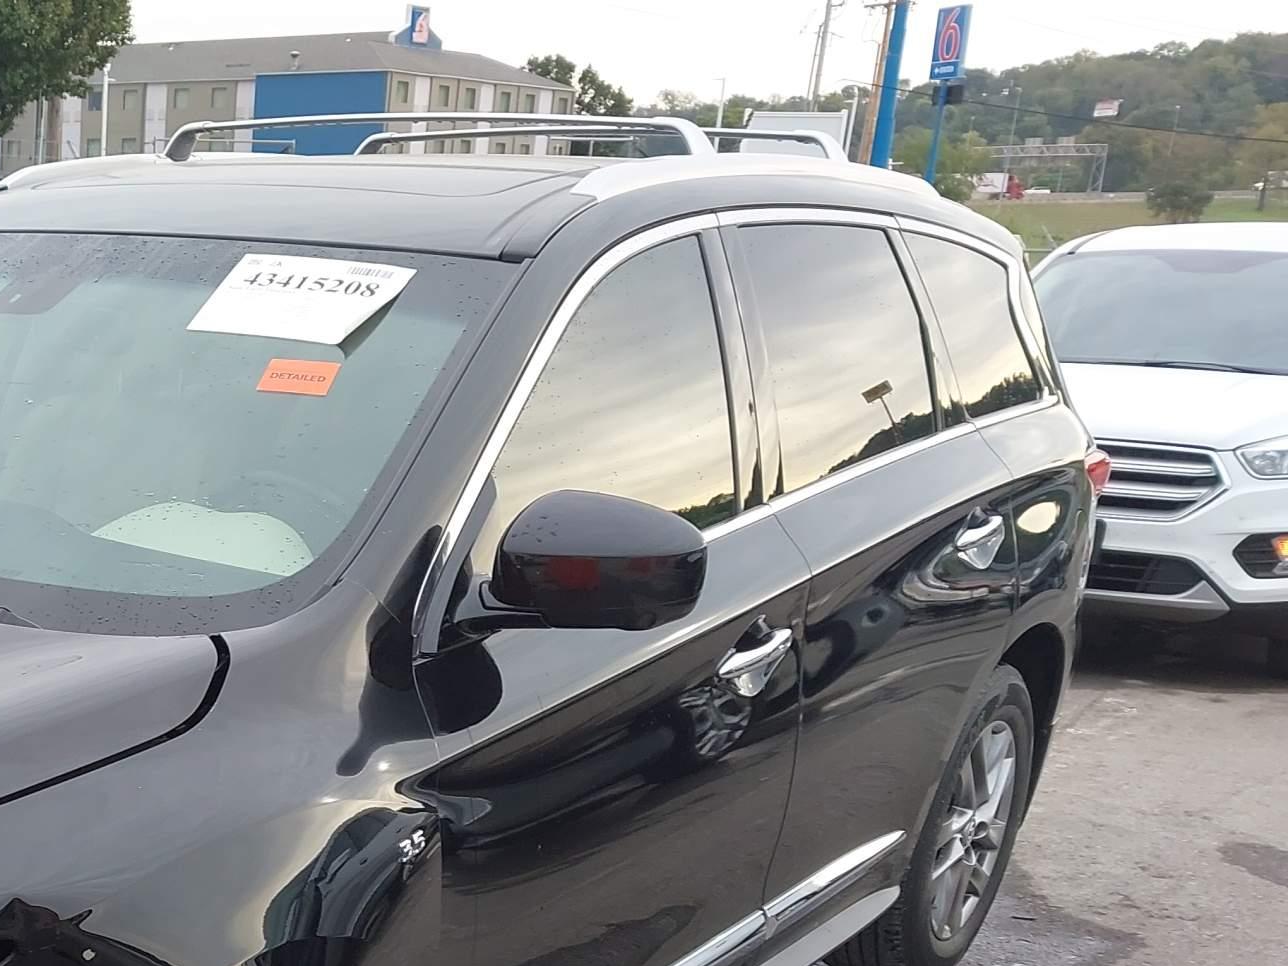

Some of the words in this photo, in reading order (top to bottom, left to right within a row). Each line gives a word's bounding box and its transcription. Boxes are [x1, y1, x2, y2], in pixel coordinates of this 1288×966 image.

[938, 7, 961, 62] 6
[243, 271, 380, 298] 43415208
[269, 371, 326, 384] DETAILED
